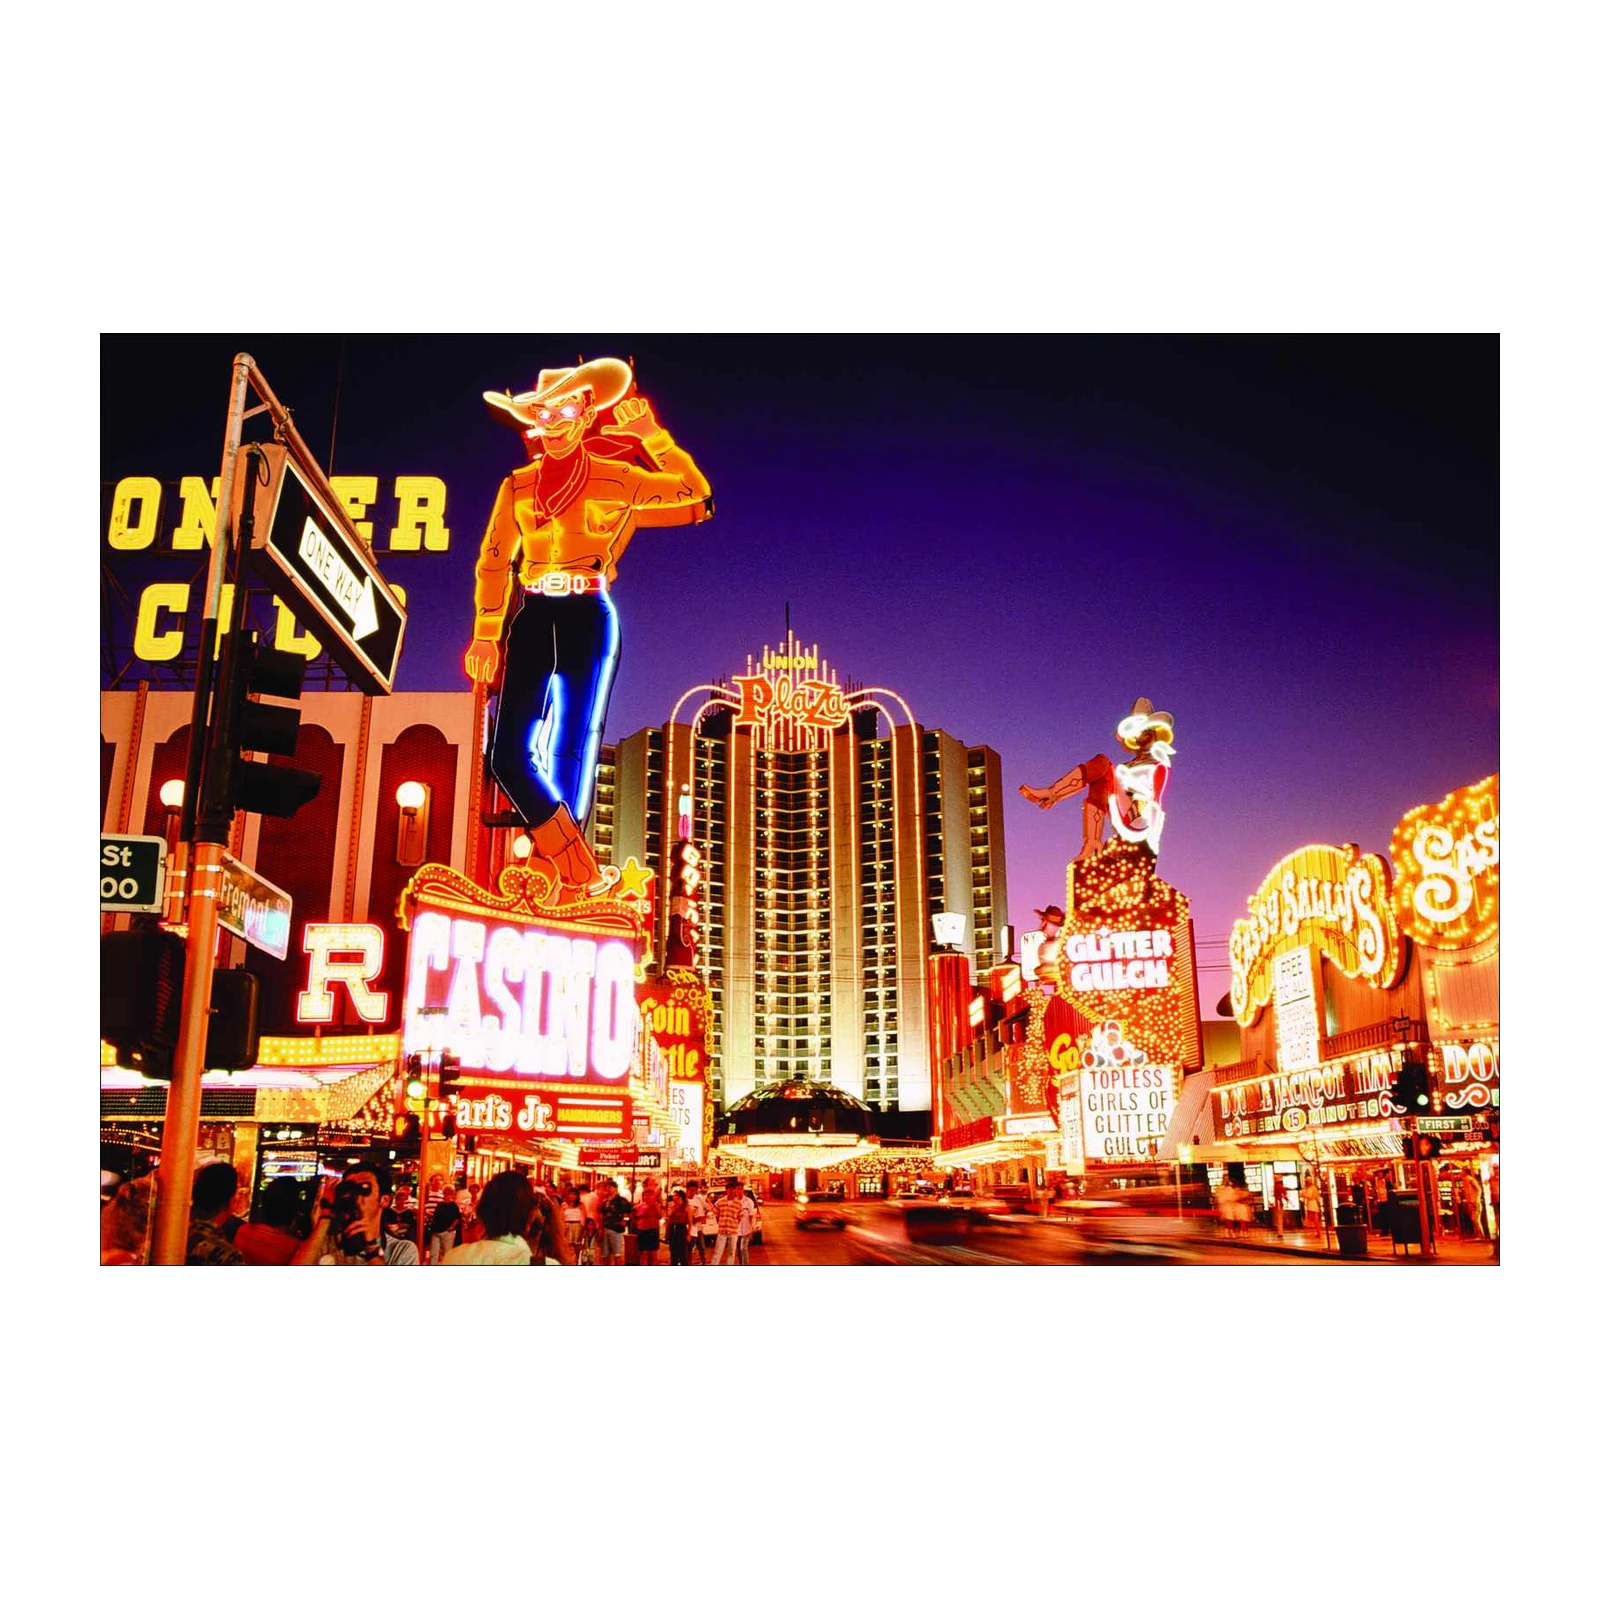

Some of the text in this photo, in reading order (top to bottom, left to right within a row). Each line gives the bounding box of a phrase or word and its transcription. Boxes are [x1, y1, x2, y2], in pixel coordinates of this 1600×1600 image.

[306, 531, 363, 614] ONE WAY
[763, 656, 818, 670] UNION
[732, 674, 850, 729] Plaza
[101, 845, 132, 867] St
[220, 870, 270, 932] Fremont
[1066, 928, 1173, 962] GLITTER
[297, 922, 388, 1022] R
[1071, 960, 1169, 991] GULCH
[404, 911, 635, 1079] CASINO
[1050, 1033, 1080, 1083] Go
[1090, 1069, 1163, 1090] TOPLESS
[1220, 1080, 1274, 1118] DOUBLE
[1274, 1063, 1346, 1115] JACKPOT
[672, 1087, 685, 1105] ES
[1087, 1091, 1168, 1111] GIRLS OF
[517, 1095, 556, 1131] Jr.
[557, 1109, 624, 1124] HAMBURGERS
[1095, 1113, 1168, 1133] GLITTER
[1242, 1098, 1379, 1134] EVERY 15 MINUTES
[1425, 1120, 1455, 1129] FIRST
[1464, 1132, 1483, 1141] BEER
